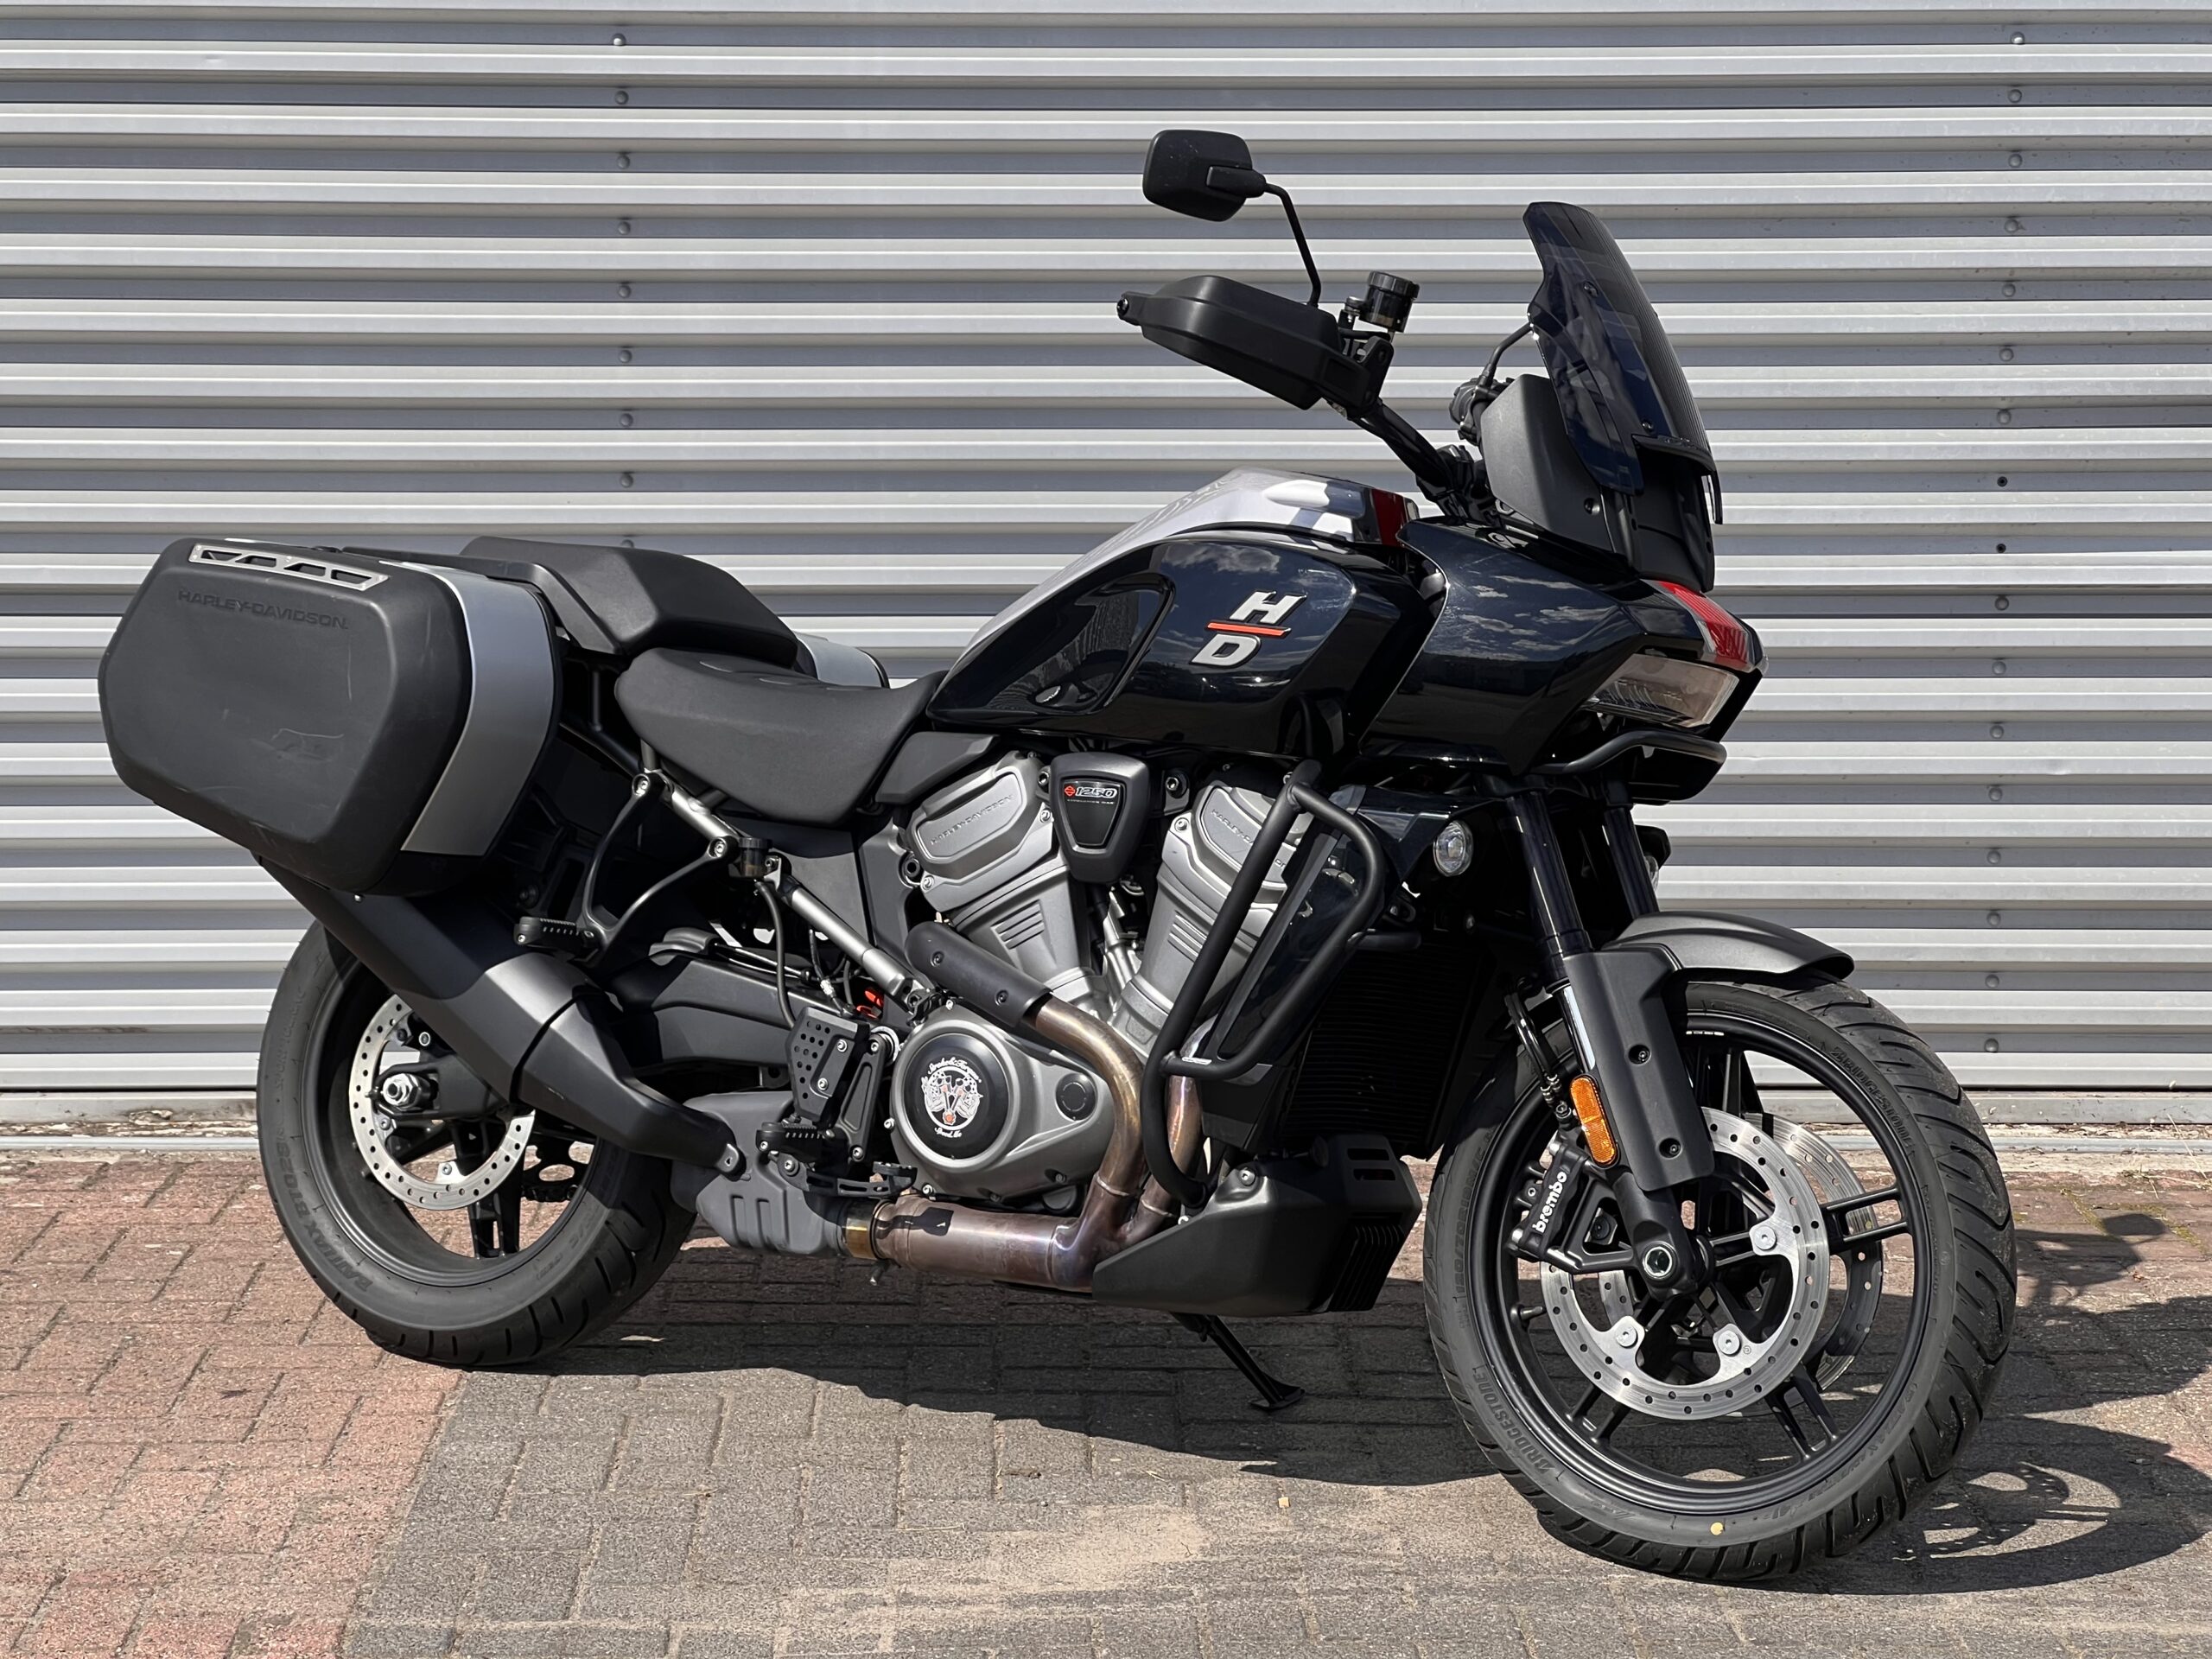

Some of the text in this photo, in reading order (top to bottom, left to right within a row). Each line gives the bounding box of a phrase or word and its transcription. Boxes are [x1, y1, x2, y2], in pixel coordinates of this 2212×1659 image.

[1075, 785, 1118, 799] 1250
[1829, 1046, 1916, 1149] BRIDGESTONE
[1531, 1171, 1567, 1234] brembo
[1472, 1371, 1555, 1474] BRIDGESTONE
